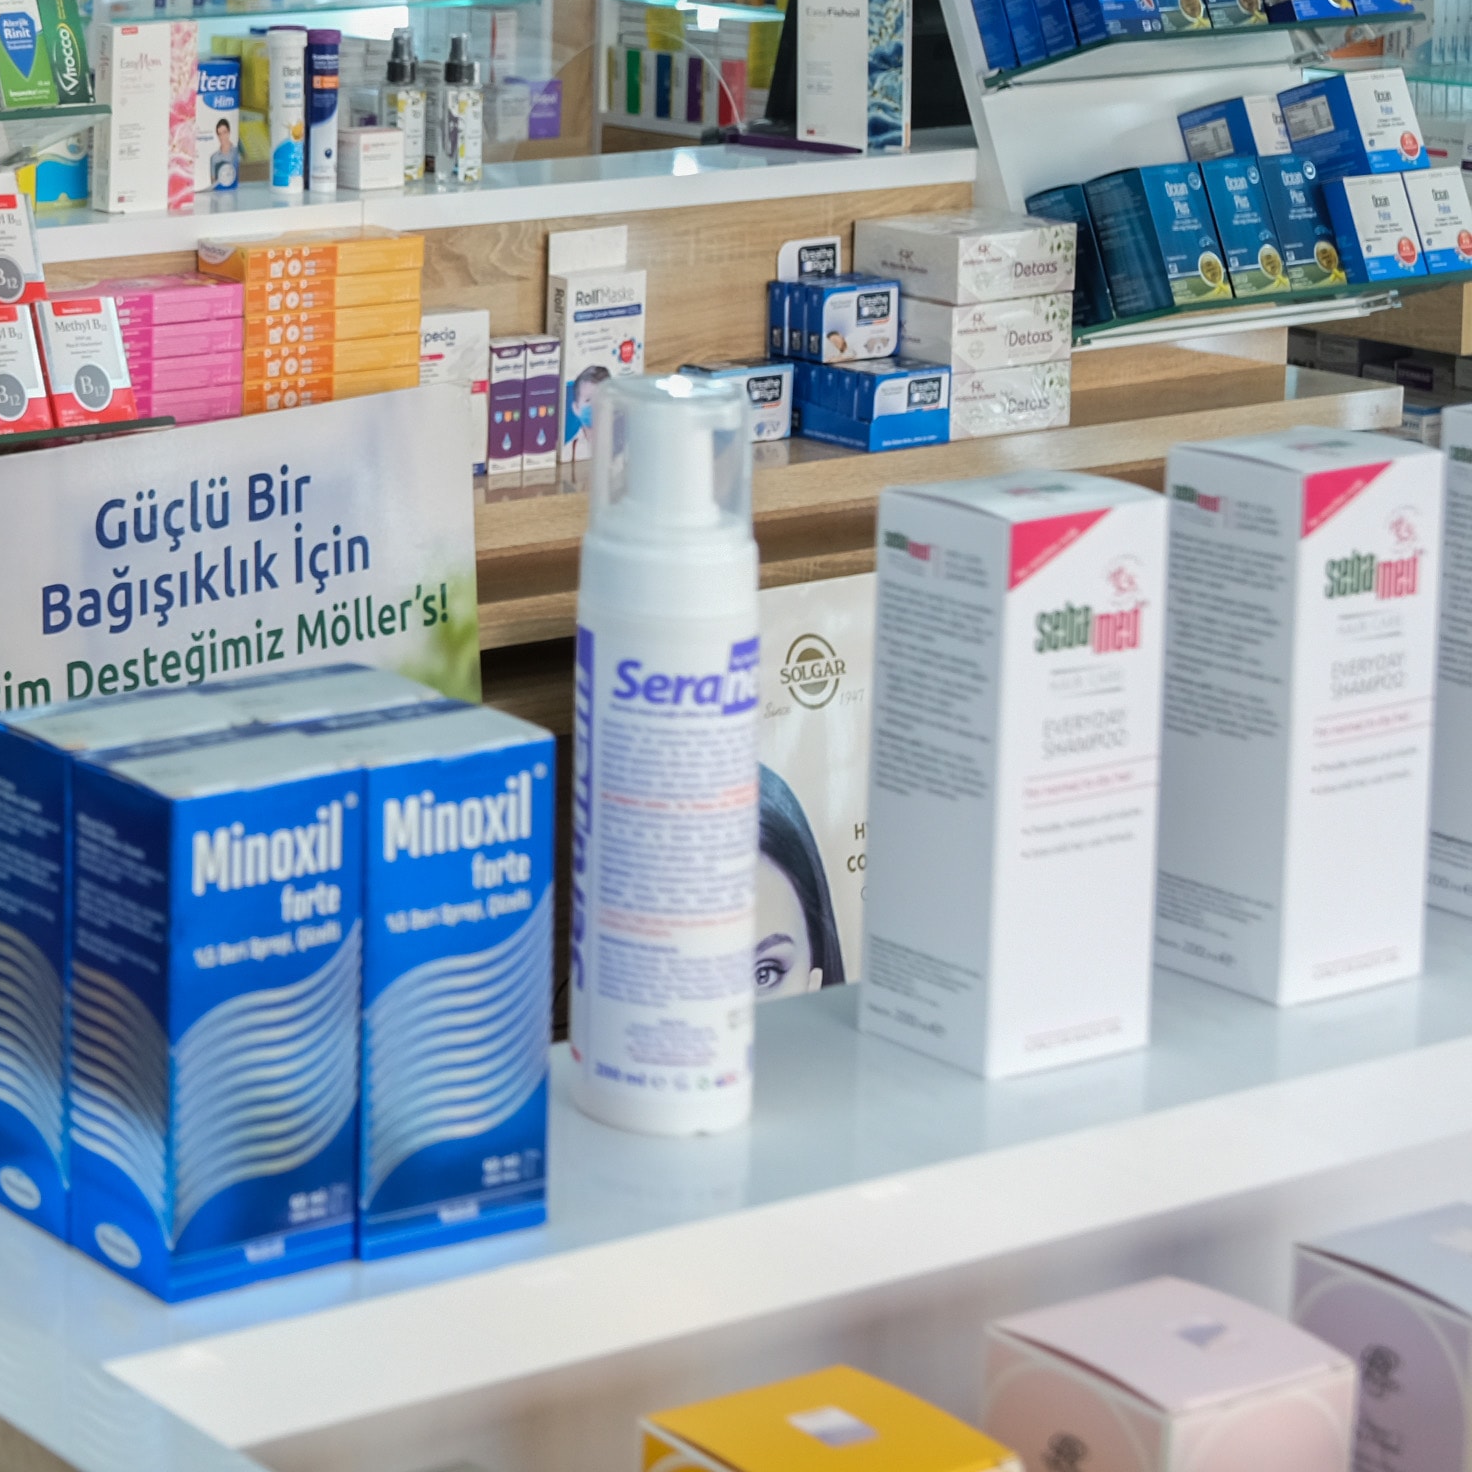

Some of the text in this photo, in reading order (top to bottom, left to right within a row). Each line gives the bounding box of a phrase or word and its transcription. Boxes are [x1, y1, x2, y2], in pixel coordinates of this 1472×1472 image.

[4, 28, 31, 39] Rinit
[214, 96, 234, 107] Him
[1014, 262, 1058, 278] Detoxs
[1009, 331, 1053, 347] Detoxs
[96, 464, 312, 553] Güçlü Bir
[42, 522, 372, 636] Bağışıklık İçin
[1324, 549, 1422, 600] sebamed
[66, 618, 286, 702] Desteğimiz
[296, 582, 450, 656] Möller's!
[1034, 600, 1143, 656] sebamed
[779, 659, 847, 684] SOLGAR
[383, 770, 533, 863] Minoxil
[192, 799, 344, 897] Minoxil
[472, 850, 532, 891] forte
[281, 882, 342, 924] forte
